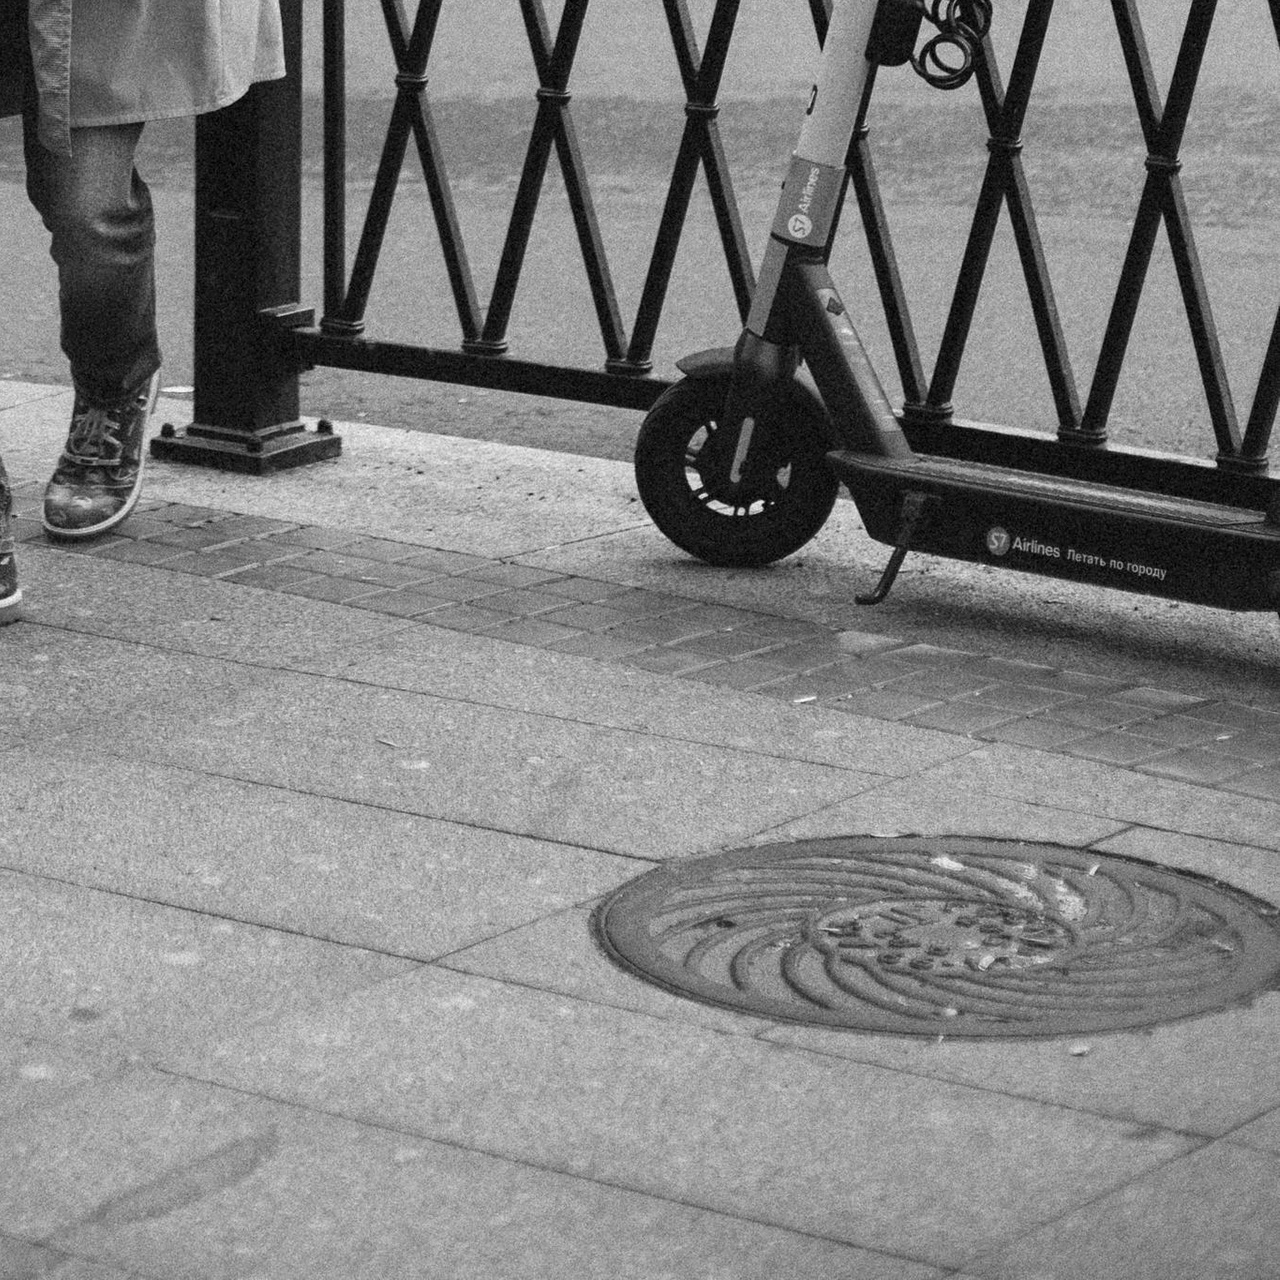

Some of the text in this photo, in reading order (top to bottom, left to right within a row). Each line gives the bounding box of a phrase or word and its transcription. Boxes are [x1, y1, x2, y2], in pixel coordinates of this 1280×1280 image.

[799, 167, 820, 214] Airlines
[1012, 537, 1061, 558] Airlines
[1067, 549, 1167, 581] Летать по городу
